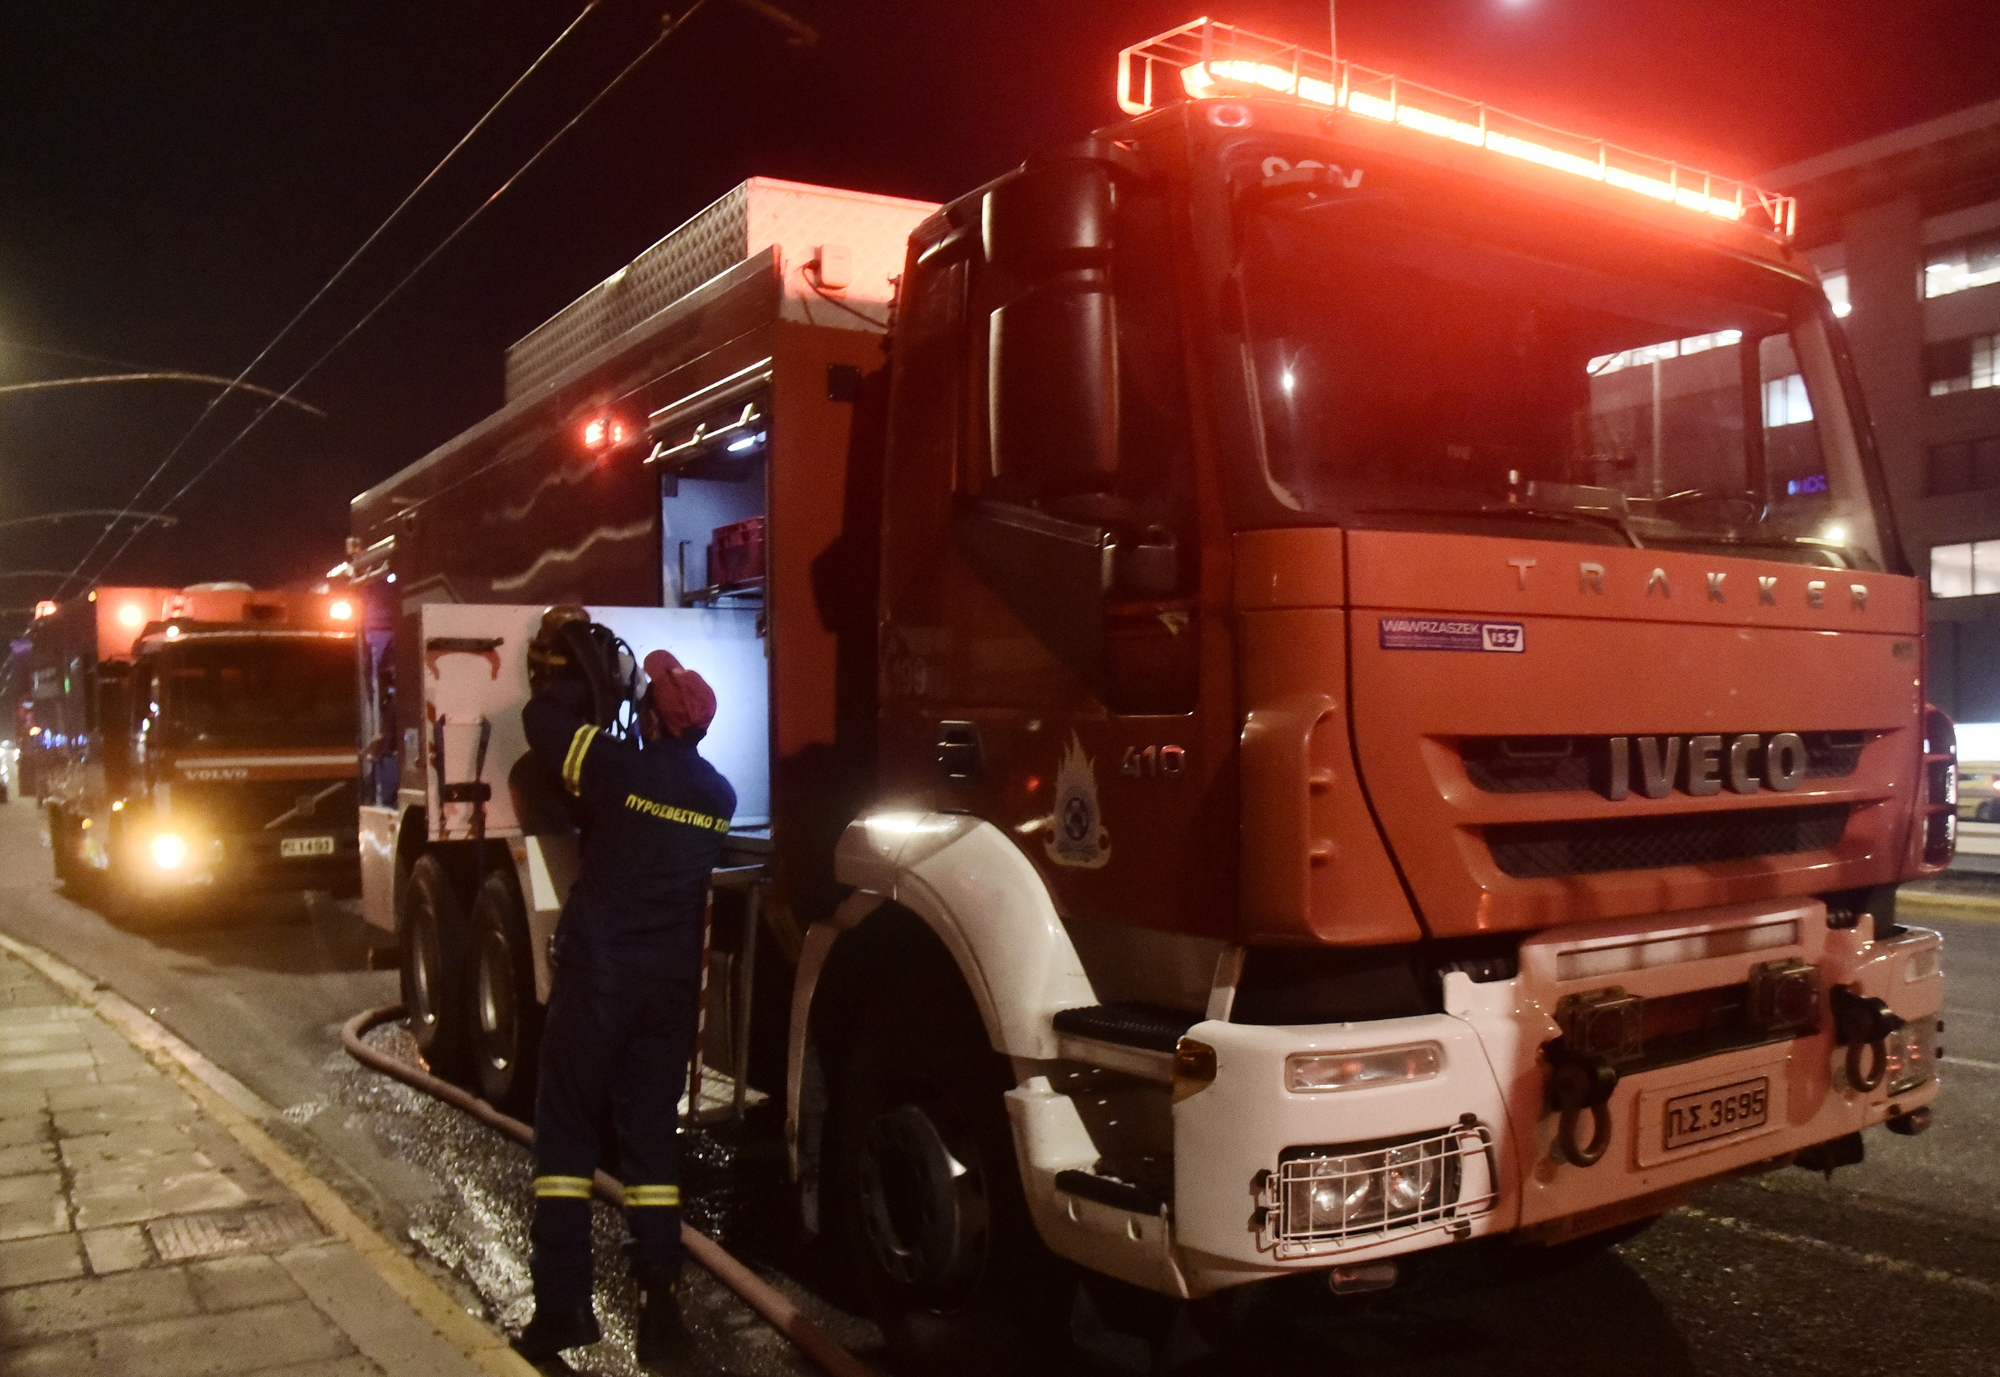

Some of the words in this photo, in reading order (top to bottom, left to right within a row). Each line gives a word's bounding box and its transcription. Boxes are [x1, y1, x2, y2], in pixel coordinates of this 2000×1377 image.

[1508, 559, 1868, 611] TRAKKER
[1382, 620, 1480, 634] WAWRZASZEK
[186, 769, 248, 781] VOLVO
[1120, 744, 1187, 778] 410
[1610, 733, 1806, 801] IVECO
[625, 794, 713, 829] ΠΥΡΟΣΒΕΣΤΙΚΟ
